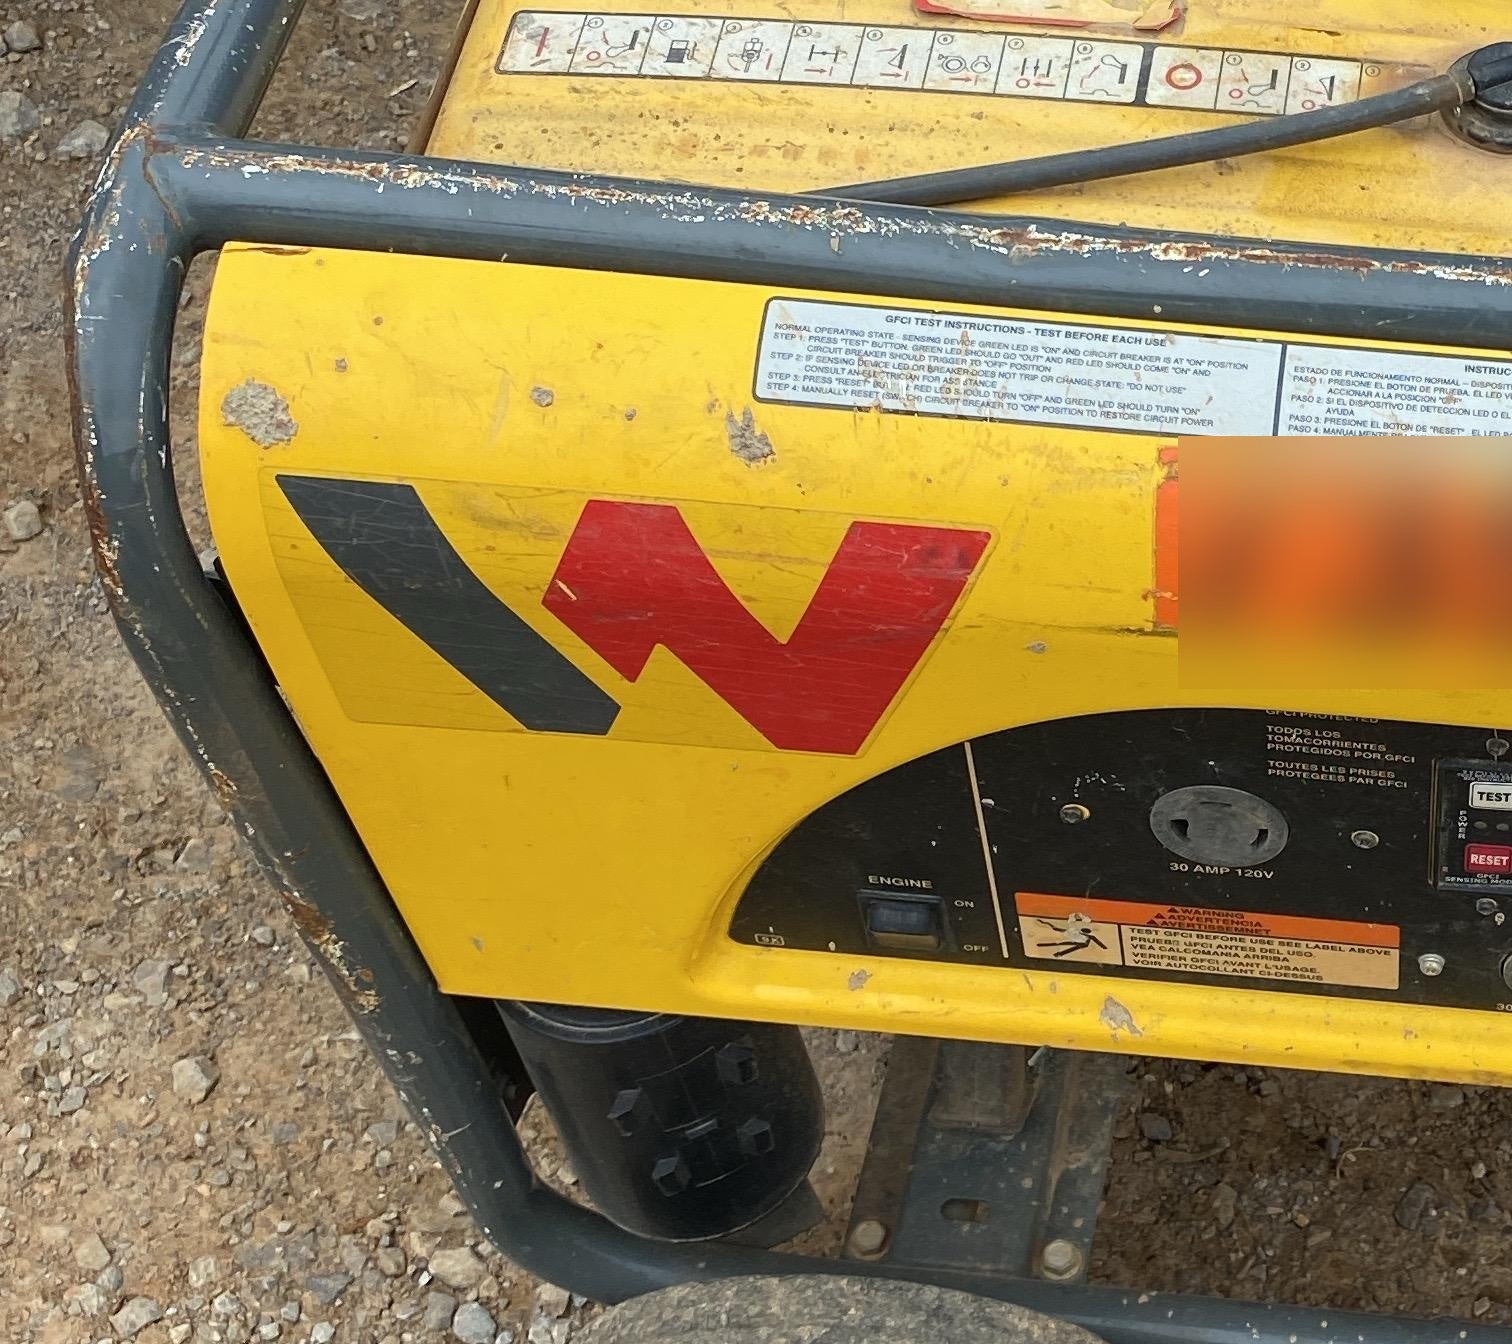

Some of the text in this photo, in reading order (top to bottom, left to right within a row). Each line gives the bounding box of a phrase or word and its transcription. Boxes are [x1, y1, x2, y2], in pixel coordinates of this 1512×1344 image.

[886, 314, 1167, 347] GFCI TEST INSTRUCTIONS TEST BEFORE EACH USE
[1266, 724, 1342, 739] TODOS LOS
[1266, 734, 1387, 752] TOMACORRIENTES
[1267, 743, 1415, 764] PROTEGIDOS POR GFCI
[1267, 760, 1396, 779] TOUTES LES PRISES
[1267, 768, 1408, 789] PROTEGEES PAR GFCI
[1477, 791, 1512, 803] TEST
[1457, 809, 1468, 840] POWER
[1470, 853, 1510, 867] RESET
[1169, 861, 1274, 881] 30 AMP 120V
[867, 874, 934, 889] ENGINE
[1444, 875, 1488, 885] SENSING
[953, 899, 975, 909] ON
[1180, 906, 1246, 919] WARNING
[1168, 913, 1263, 928] ADVERTENCIA
[963, 943, 990, 954] OFF
[1129, 927, 1392, 956] TEST GFCI BEFORE USE SEE LABEL ABOVE
[1214, 942, 1254, 953] ANTES
[1258, 946, 1282, 955] DEL
[1285, 948, 1315, 958] USO.
[1131, 944, 1290, 962] VEA CALCOMANIA ARRIBA
[1133, 959, 1324, 981] VOIR AUTOCOLLANT CI-DESSUS
